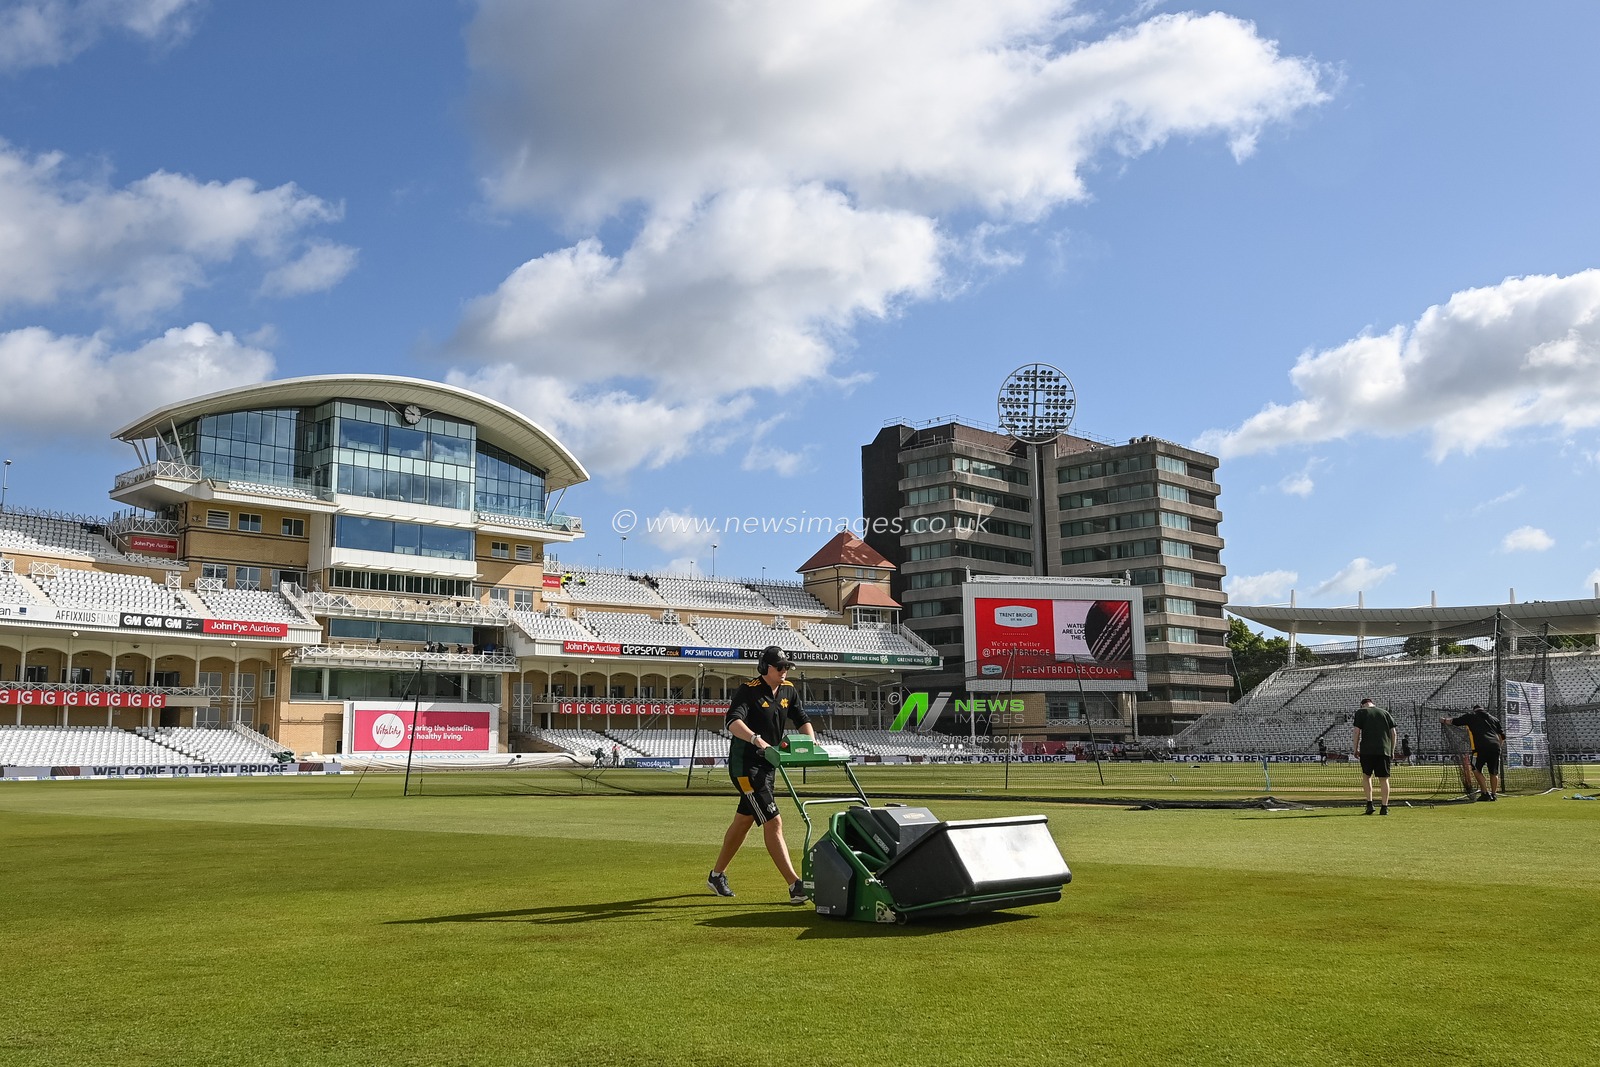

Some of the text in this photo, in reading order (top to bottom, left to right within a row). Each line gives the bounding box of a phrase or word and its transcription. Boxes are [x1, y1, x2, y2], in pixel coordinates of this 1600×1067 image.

[123, 615, 142, 626] GM
[144, 616, 162, 628] GM
[164, 618, 182, 629] GM
[211, 621, 281, 633] John Pye Auctions
[565, 642, 620, 653] John Pye Auctions
[713, 650, 735, 658] COOPER
[793, 653, 839, 661] SUTHERLAND
[1020, 666, 1119, 674] TRENTBRIDGE.CO.UK
[17, 690, 33, 704] IG
[40, 691, 56, 705] IG
[63, 692, 78, 705] IG
[85, 692, 100, 706] IG
[106, 693, 121, 706] IG
[128, 694, 142, 707] IG
[148, 694, 162, 707] IG
[562, 703, 572, 714] IG
[576, 703, 586, 714] IG
[590, 704, 600, 714] IG
[605, 704, 616, 714] IG
[621, 704, 631, 714] IG
[635, 704, 646, 715] IG
[650, 704, 661, 715] IG
[665, 704, 675, 715] IG
[375, 724, 403, 738] Vitality
[434, 724, 446, 732] the
[446, 724, 474, 732] benefits
[416, 732, 442, 741] healthy
[443, 732, 463, 741] living.
[1170, 754, 1215, 762] ELCOME
[93, 764, 288, 776] WELCOME TO TRENT BRIDGE
